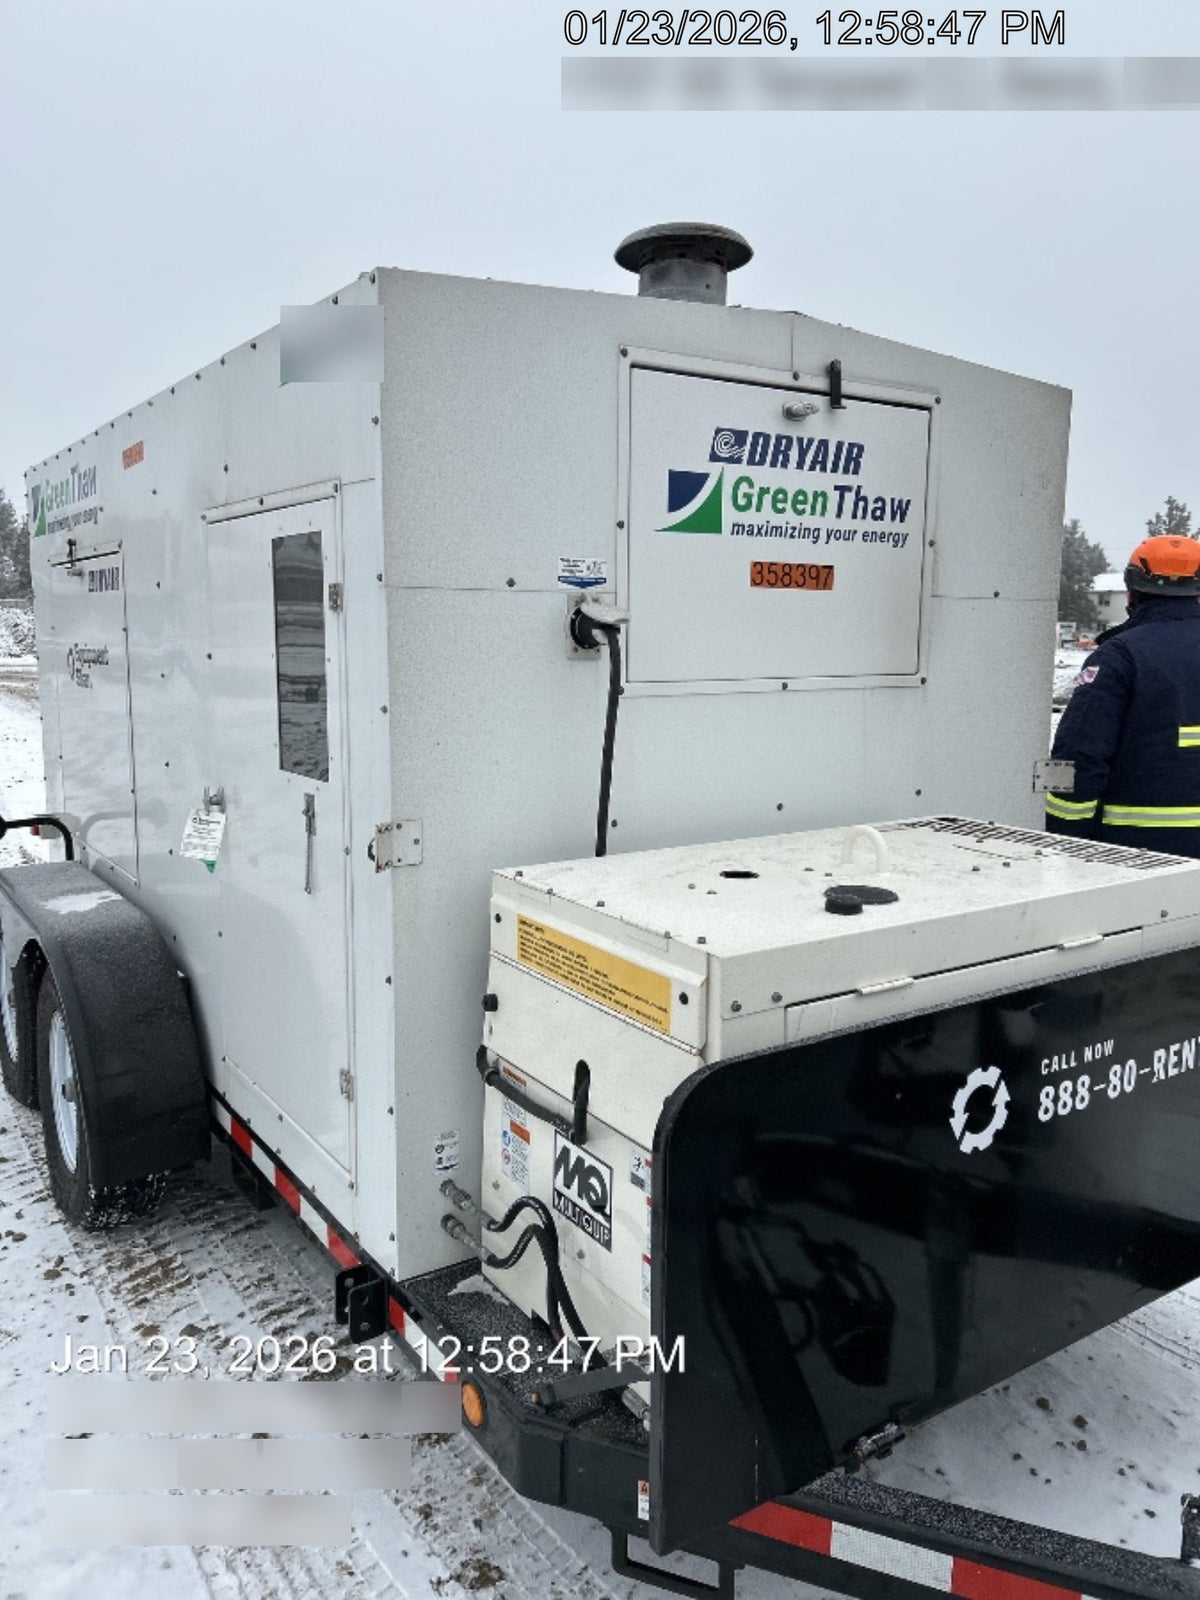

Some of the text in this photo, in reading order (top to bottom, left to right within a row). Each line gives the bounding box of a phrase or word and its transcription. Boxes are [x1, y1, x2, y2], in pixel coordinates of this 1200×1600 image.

[747, 431, 865, 476] DRYAIR
[731, 475, 912, 523] GreenThaw
[730, 520, 909, 548] maximizing your energy
[751, 561, 833, 590] 358397
[1041, 1039, 1115, 1076] CALL NOW
[1038, 1036, 1200, 1123] 888-80-REN
